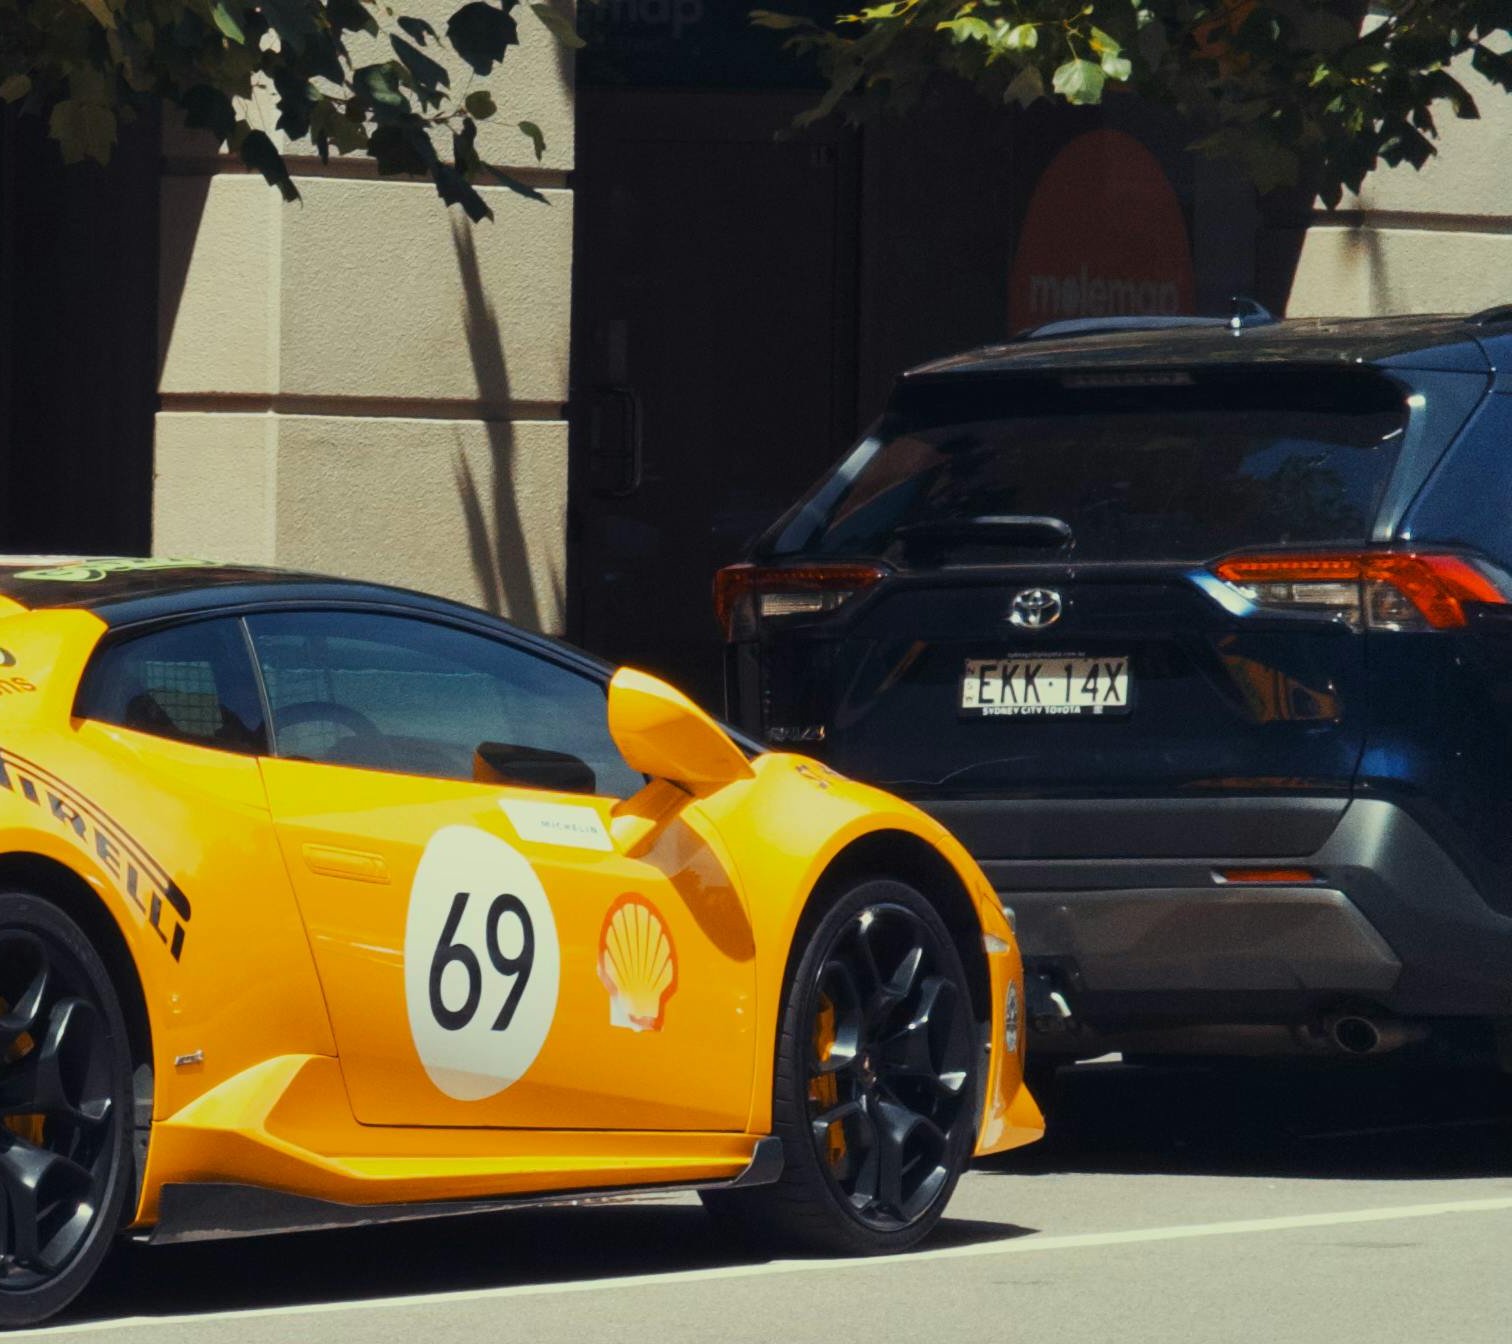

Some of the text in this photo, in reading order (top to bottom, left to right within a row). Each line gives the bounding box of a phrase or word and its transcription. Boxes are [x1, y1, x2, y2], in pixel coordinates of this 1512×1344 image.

[982, 705, 1081, 716] SYDNEY CITY TOYOTA
[428, 892, 535, 1031] 69
